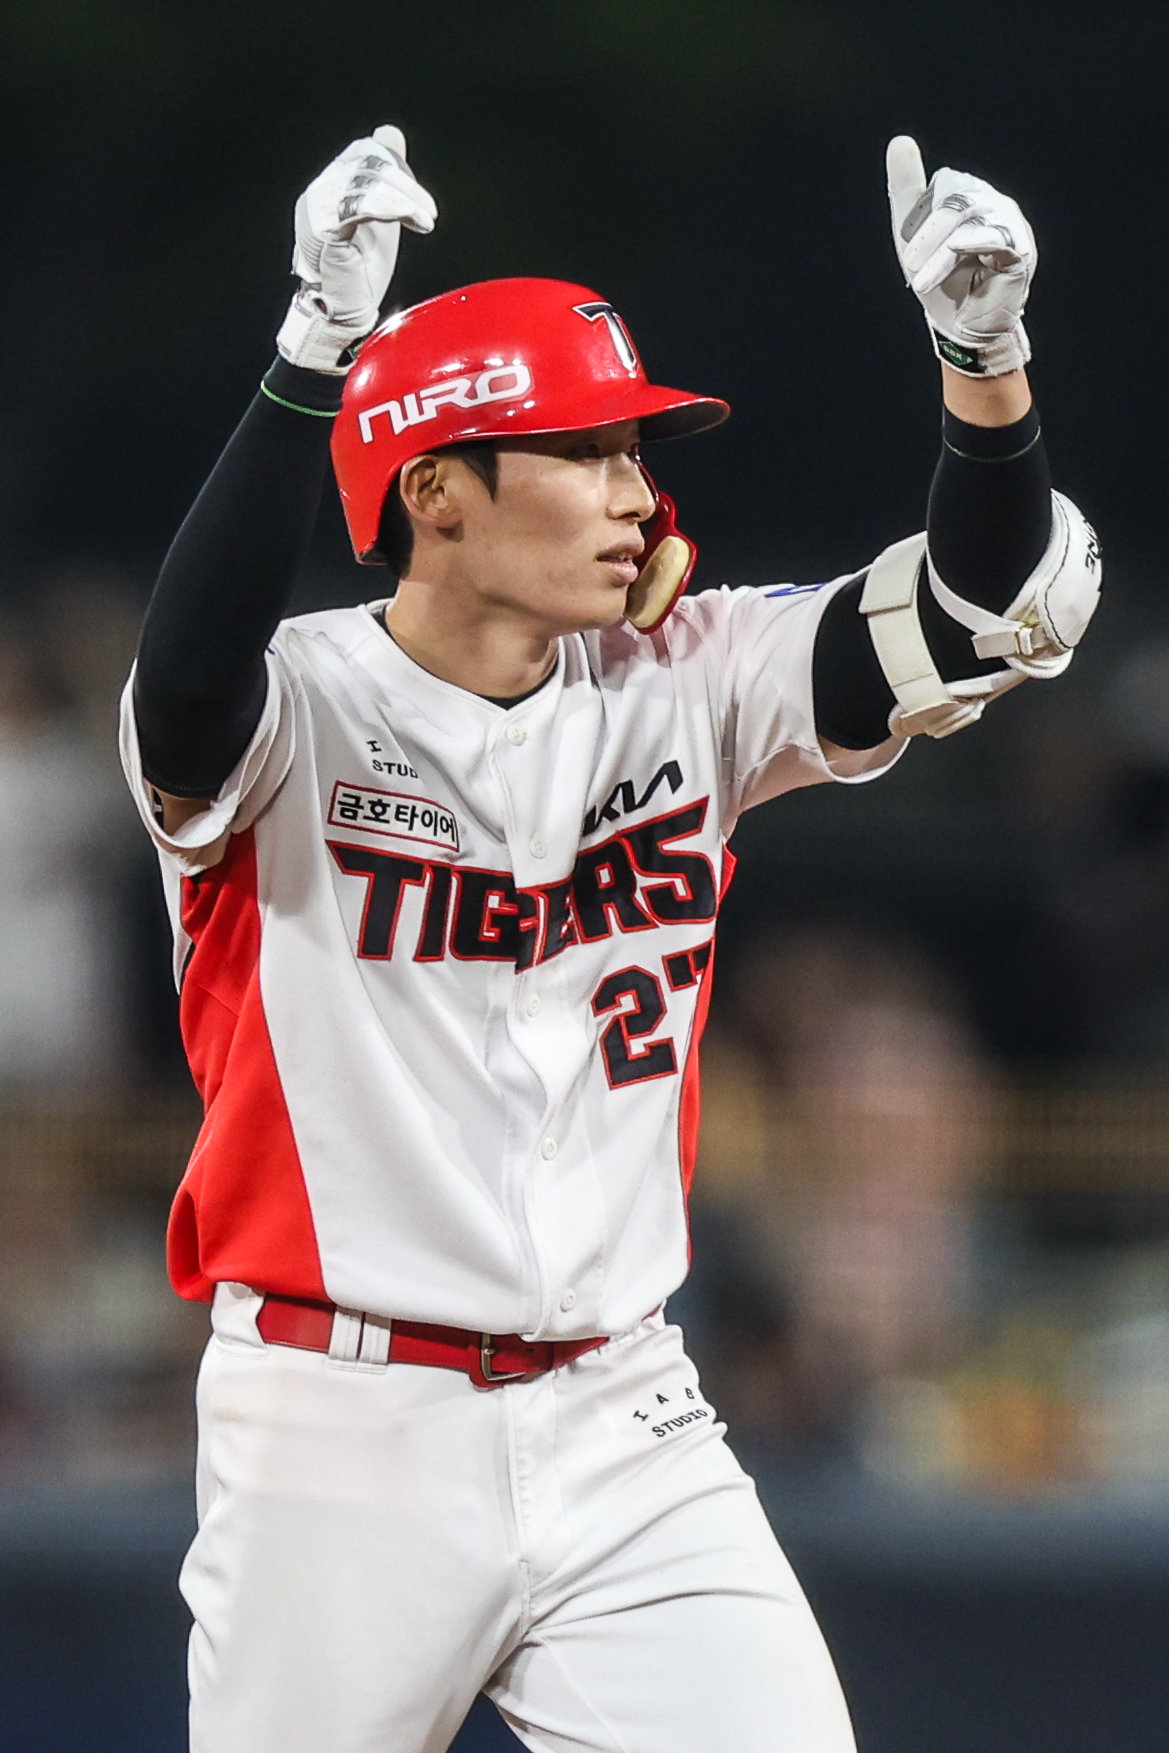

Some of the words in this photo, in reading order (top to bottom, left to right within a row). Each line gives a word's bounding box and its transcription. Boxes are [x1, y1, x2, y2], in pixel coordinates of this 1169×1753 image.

[358, 364, 533, 444] NIRO
[337, 793, 456, 842] 금호타이어
[582, 760, 684, 837] KIA
[325, 795, 717, 974] TIGERS
[651, 1409, 708, 1438] STUDIO
